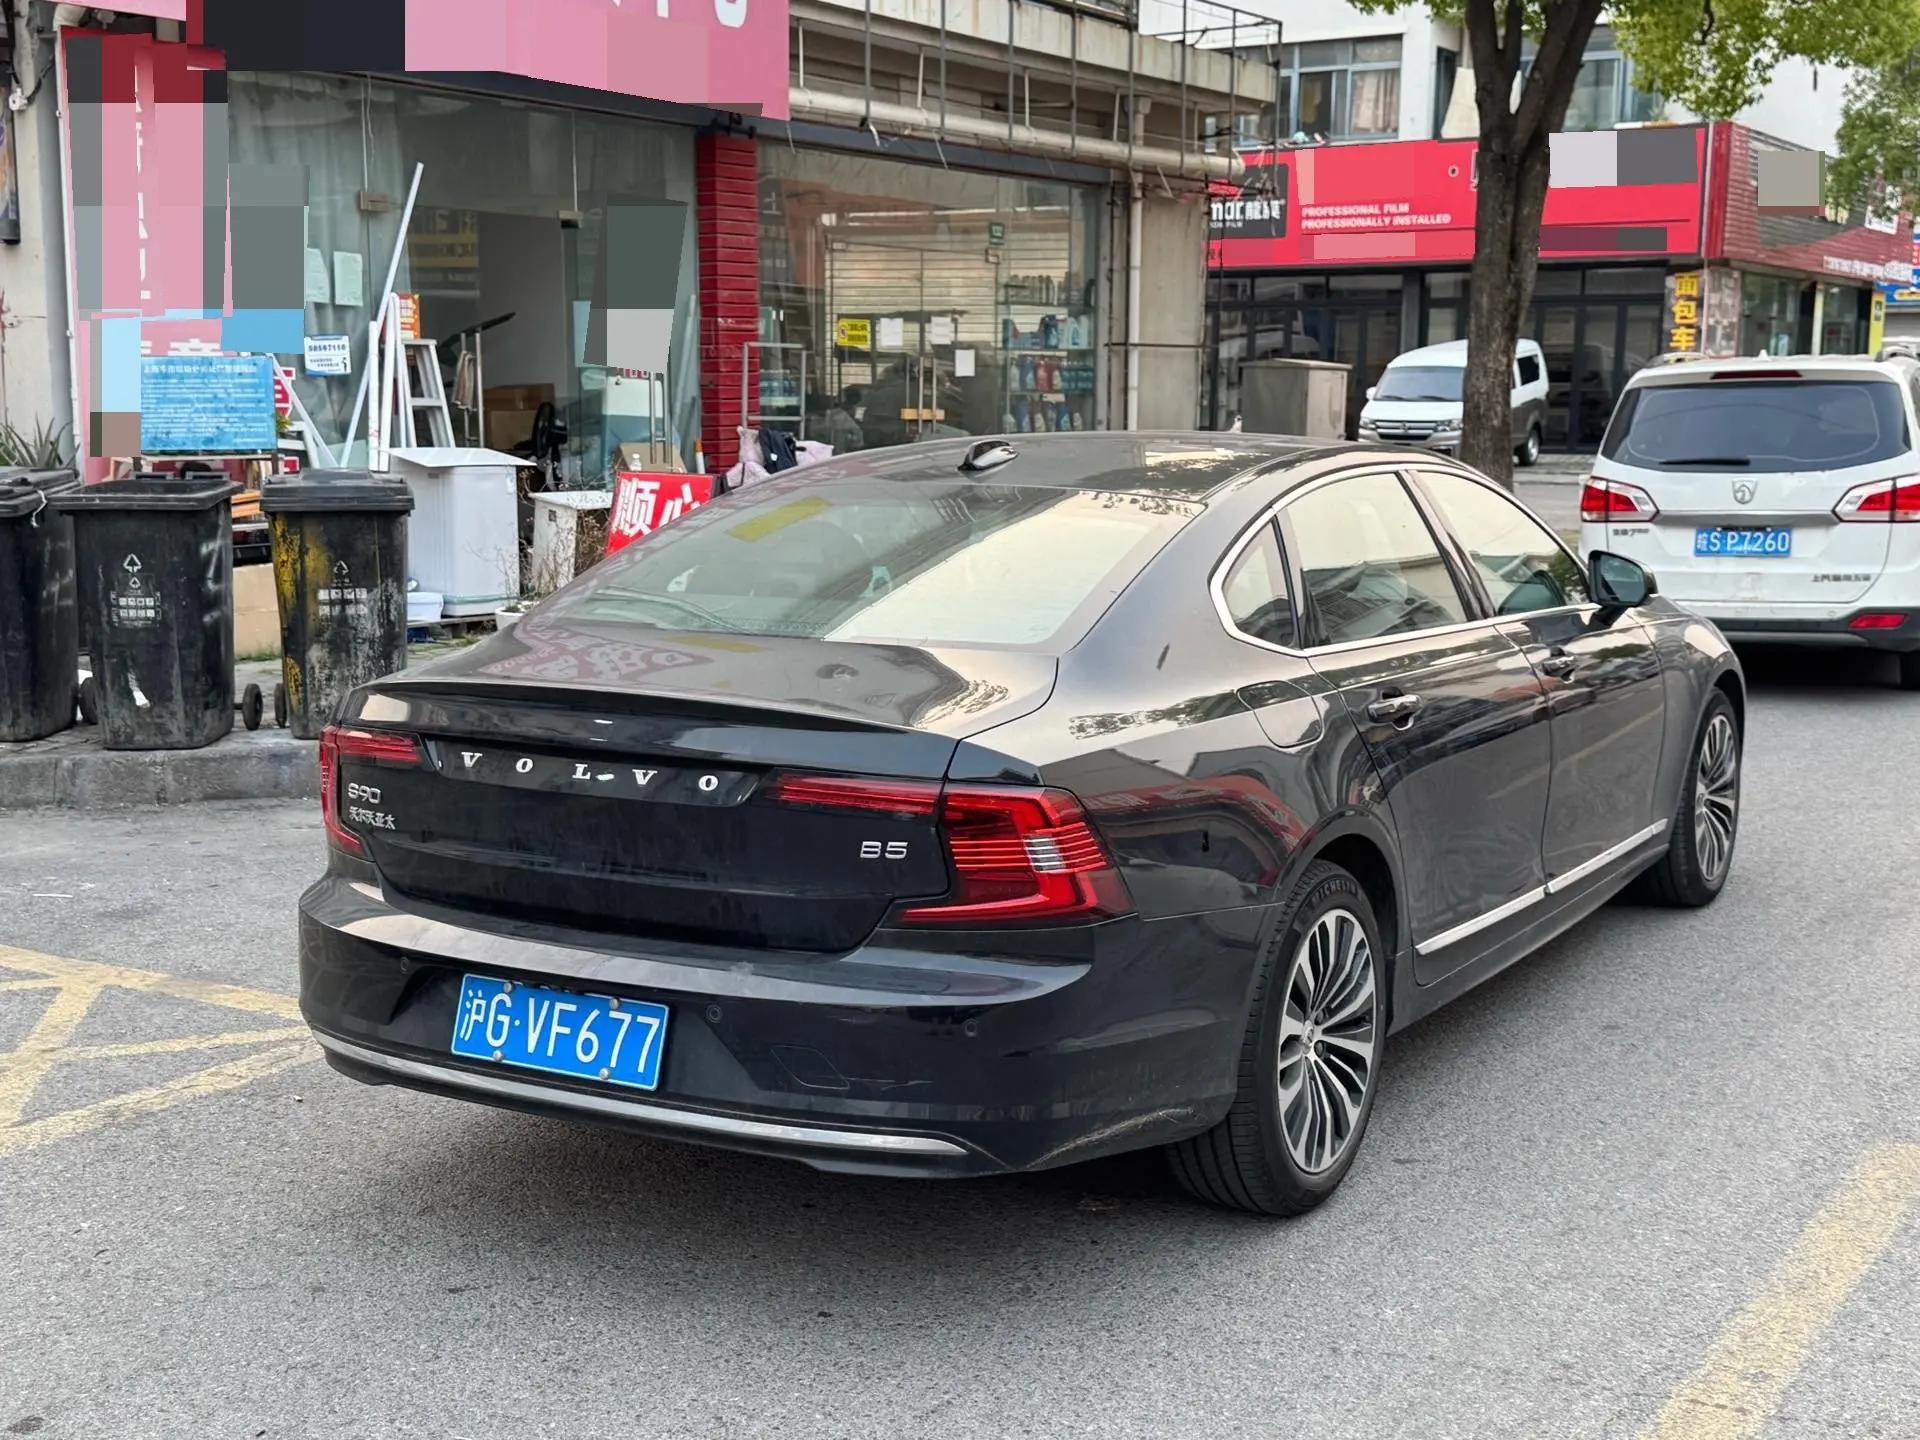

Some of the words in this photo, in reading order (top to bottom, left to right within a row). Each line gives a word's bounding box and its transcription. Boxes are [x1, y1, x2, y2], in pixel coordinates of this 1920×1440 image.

[1301, 204, 1381, 218] PROFESSIONAL
[1383, 202, 1410, 214] FILM
[1301, 216, 1391, 230] PROFESSIONALLY
[1392, 213, 1452, 226] INSTALLED
[611, 478, 701, 538] 顺心
[461, 752, 719, 791] VOLVO
[348, 783, 381, 804] S90
[349, 806, 396, 830] 沃尔沃亚太
[860, 841, 909, 860] B5
[459, 989, 661, 1074] 沪G·VF677
